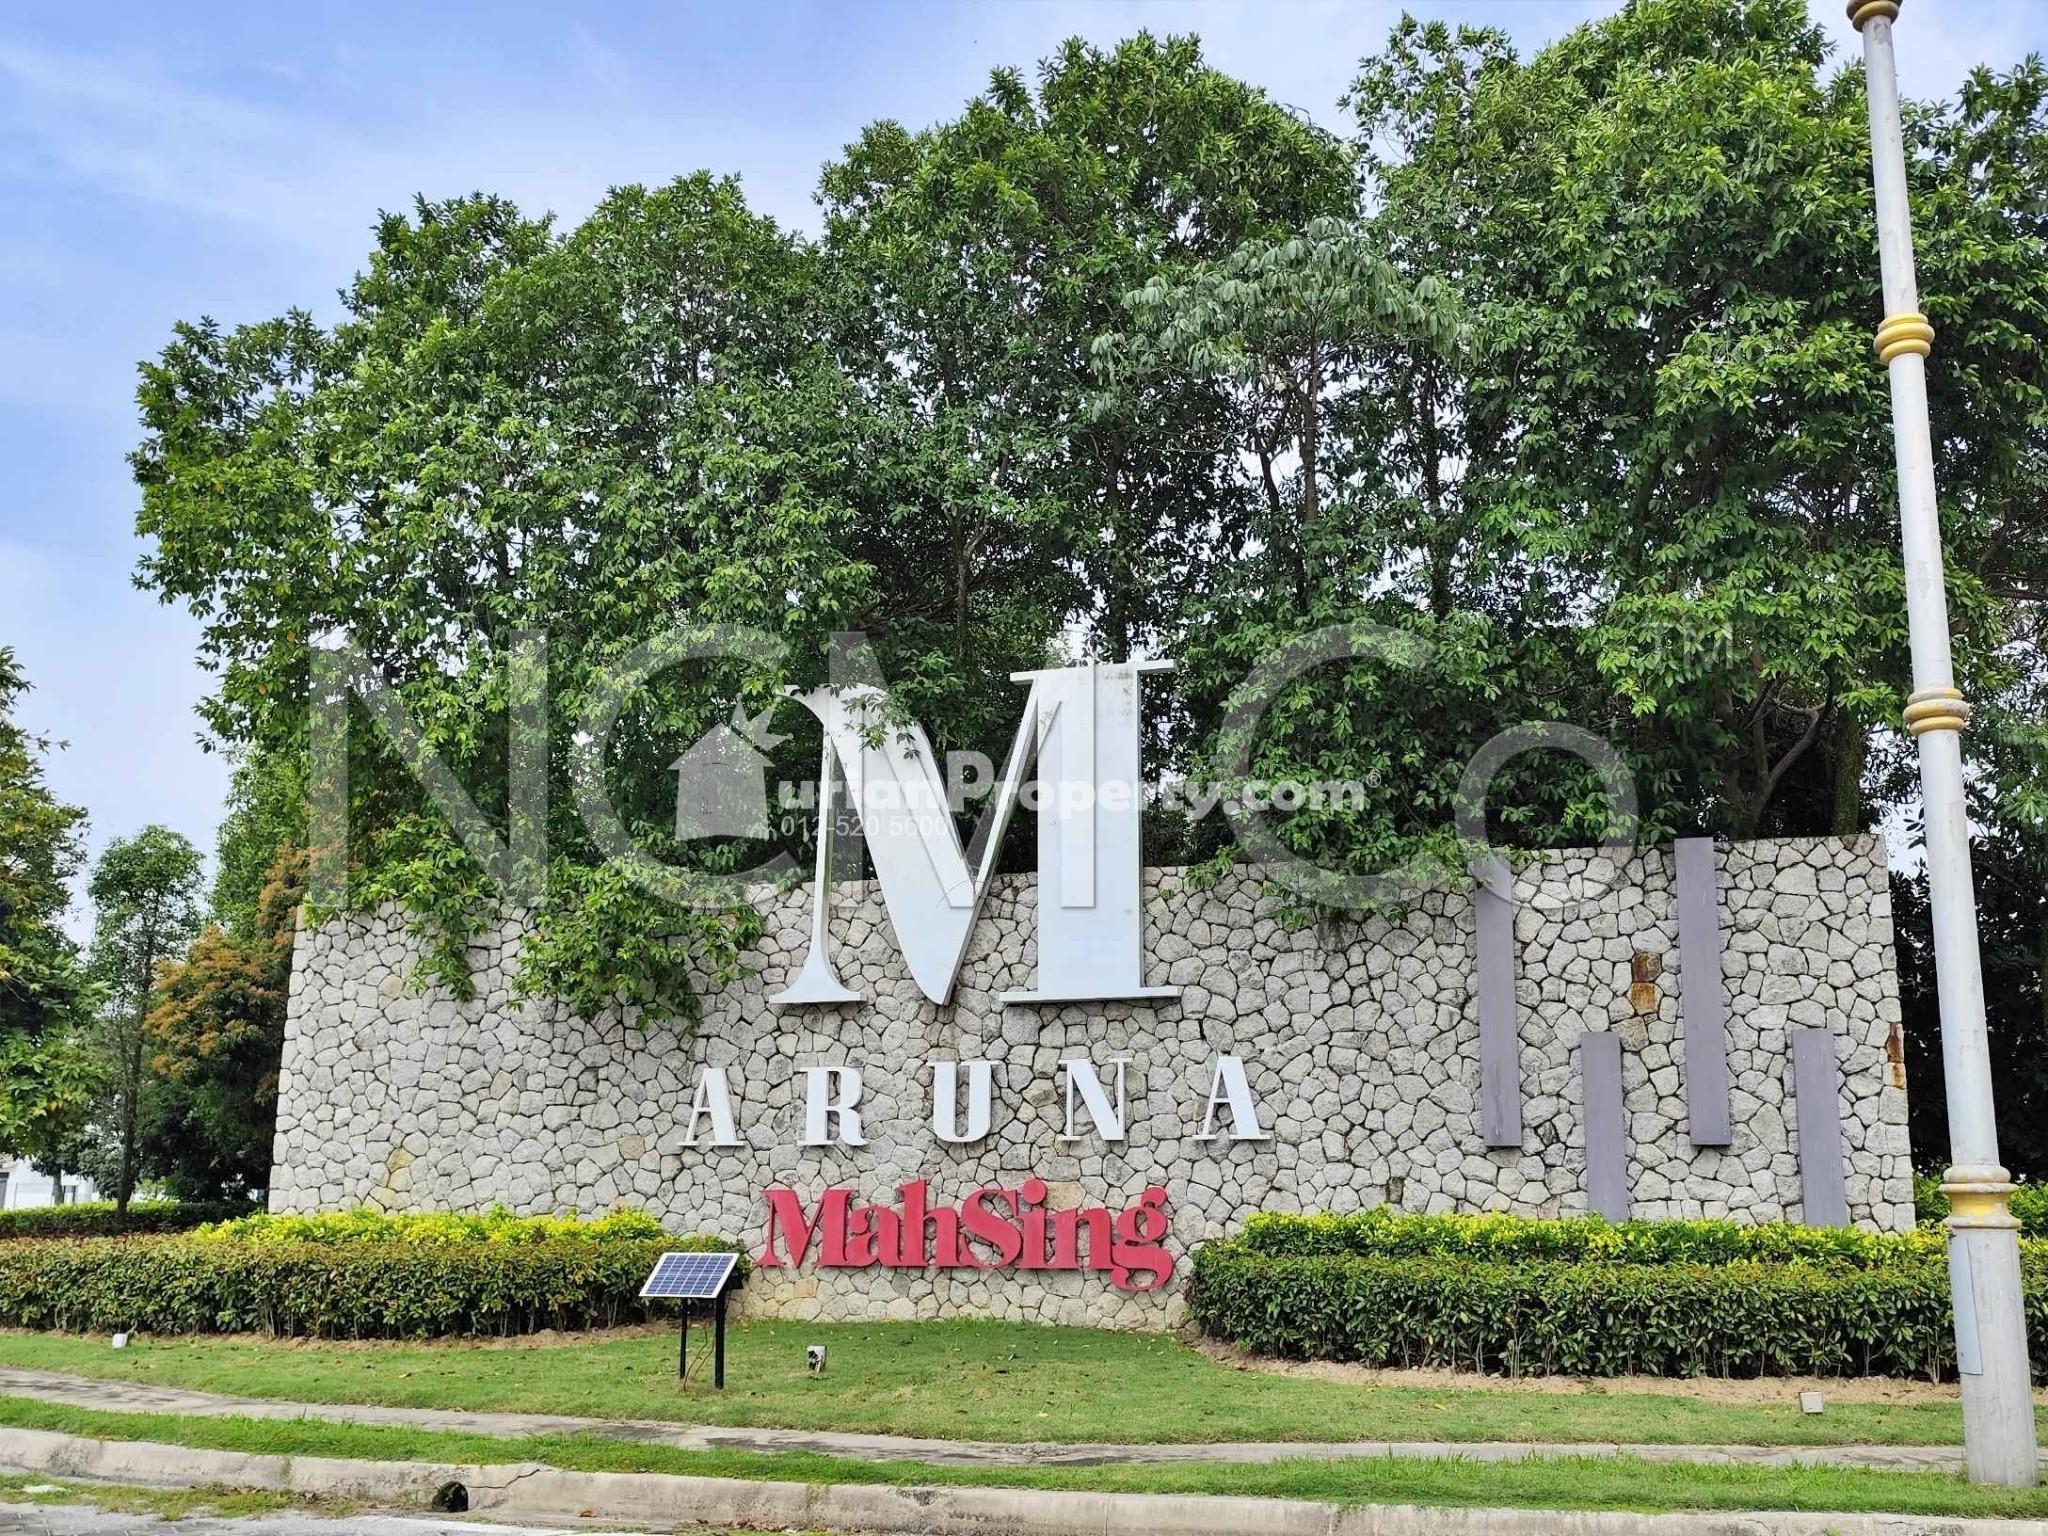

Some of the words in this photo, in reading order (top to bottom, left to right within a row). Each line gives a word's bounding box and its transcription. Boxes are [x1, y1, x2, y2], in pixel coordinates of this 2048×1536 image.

[768, 658, 1182, 1006] M
[676, 1054, 1271, 1147] ARUNA
[754, 1178, 1175, 1291] MahSing
